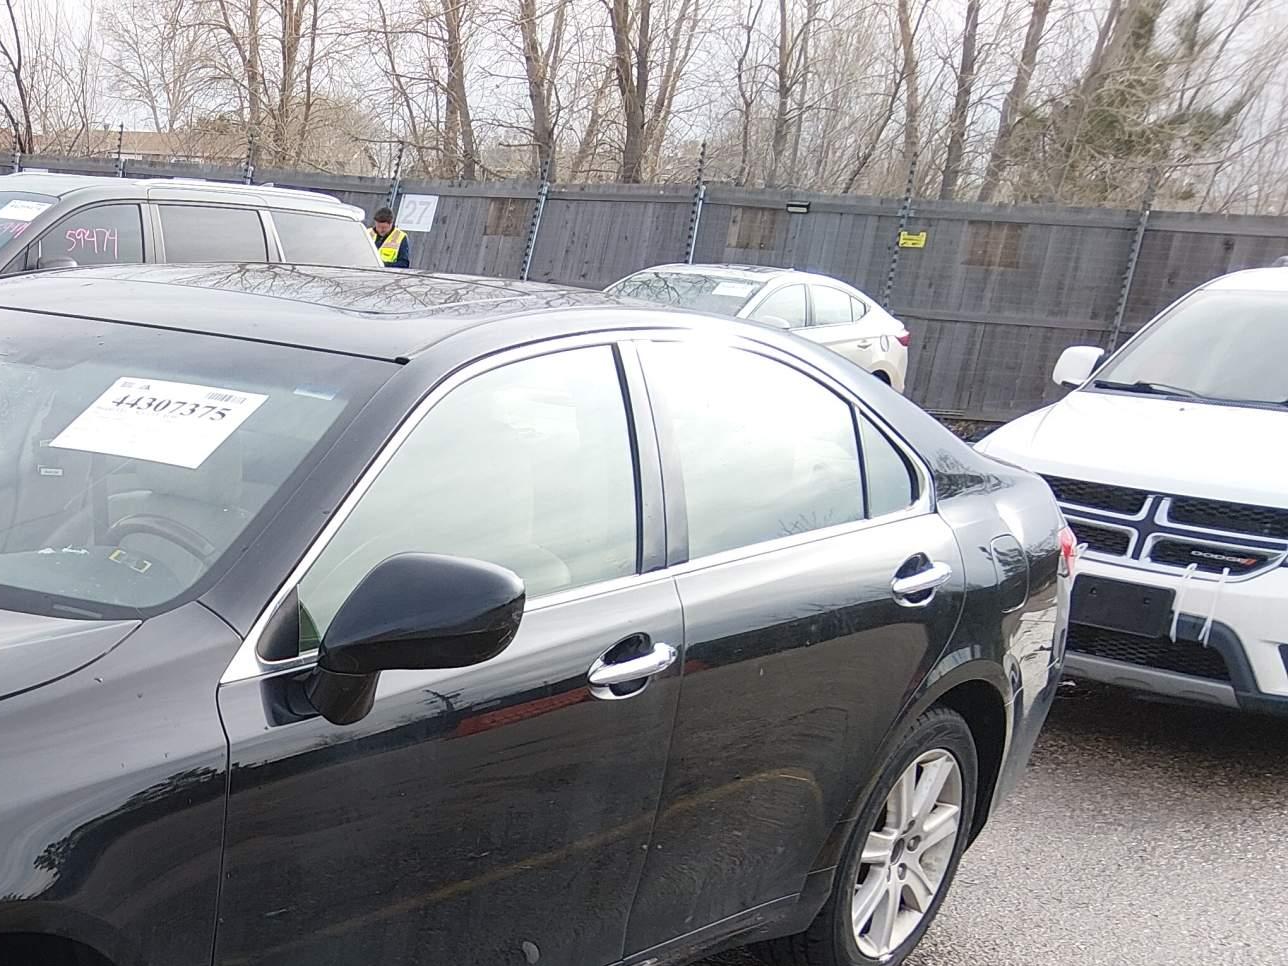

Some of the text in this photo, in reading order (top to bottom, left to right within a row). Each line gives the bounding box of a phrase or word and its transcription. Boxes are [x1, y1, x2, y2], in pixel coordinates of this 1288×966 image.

[401, 200, 432, 225] 27
[65, 227, 118, 260] 59474
[111, 393, 232, 421] 44307375
[1191, 550, 1242, 562] DODGE
